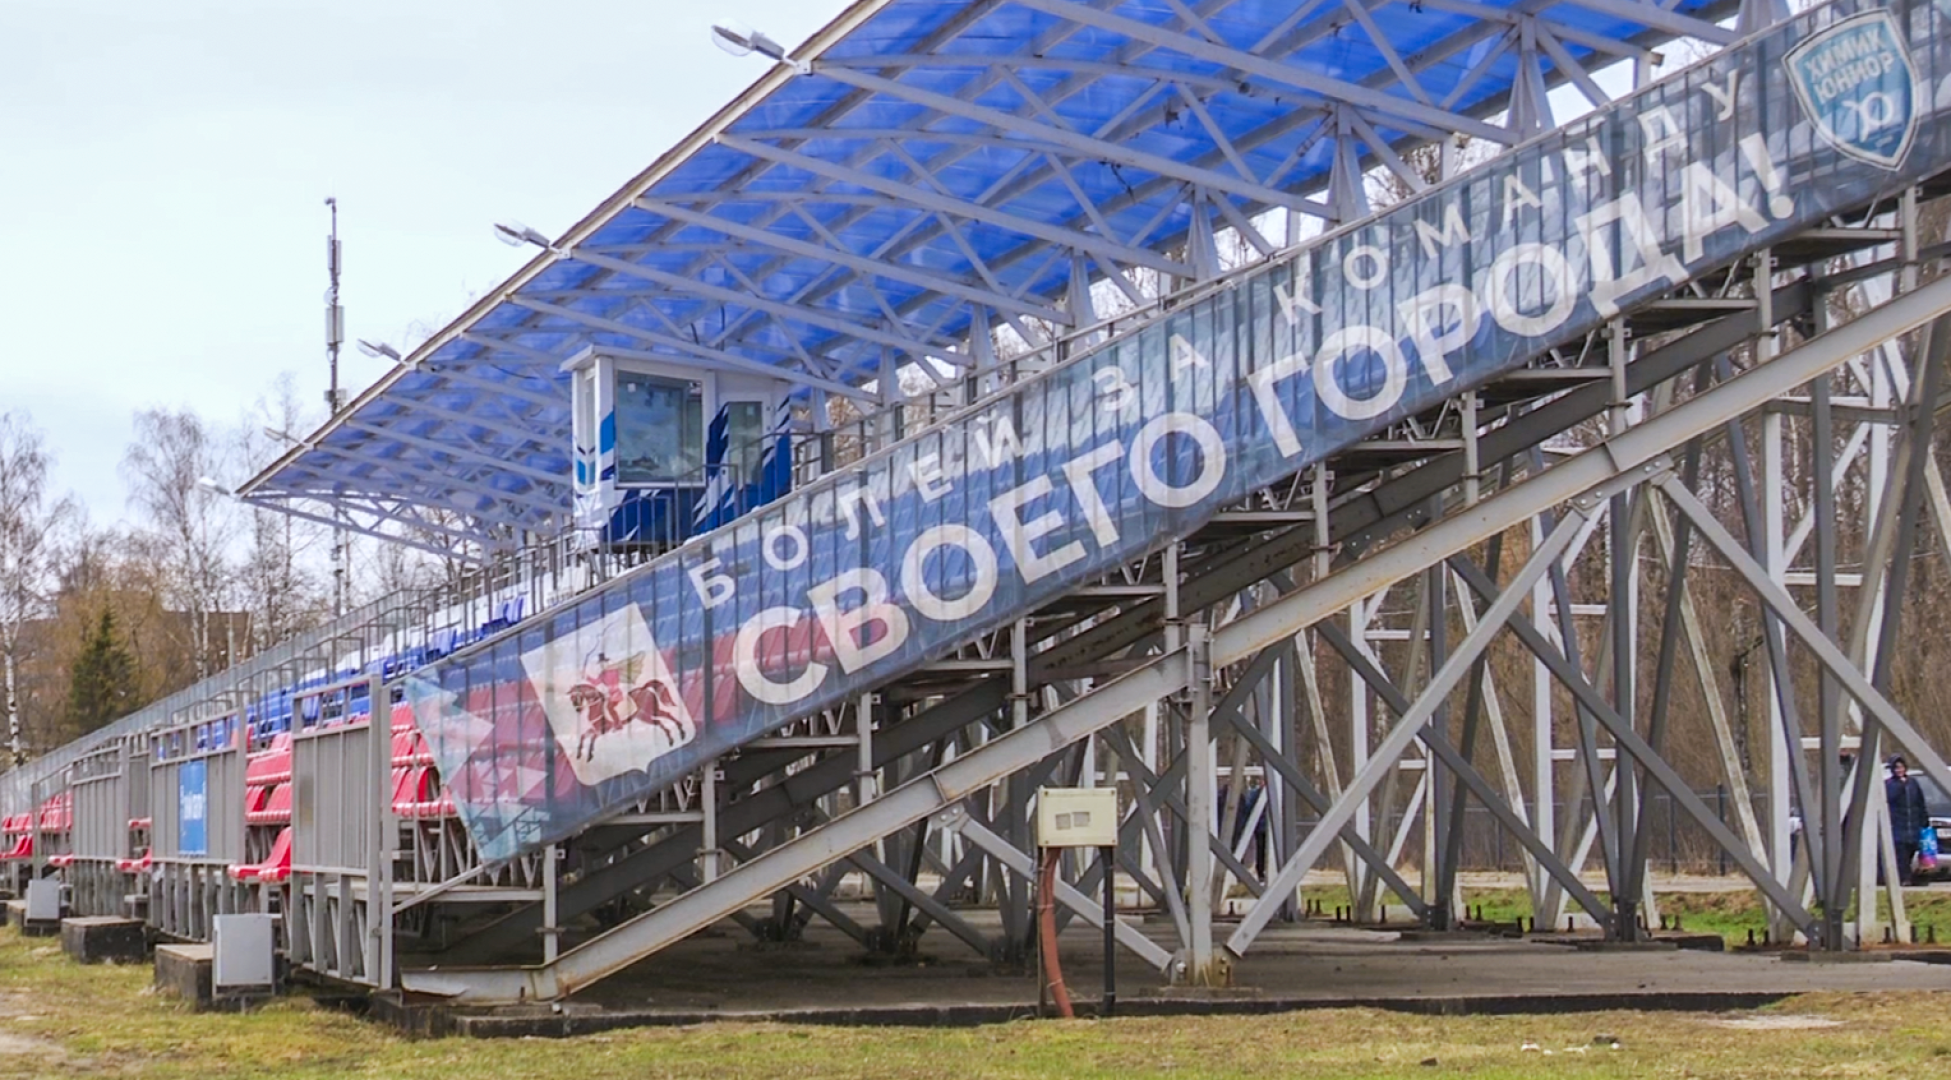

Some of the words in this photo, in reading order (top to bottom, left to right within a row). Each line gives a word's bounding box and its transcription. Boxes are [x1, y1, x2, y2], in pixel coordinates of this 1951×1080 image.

[1804, 28, 1886, 82] ХИМИК
[1812, 51, 1895, 104] ЮНИОР
[688, 410, 1024, 609] БОЛЕЙ
[1092, 332, 1210, 412] ЗА
[1273, 68, 1740, 326] КОМАНДУ
[733, 412, 1227, 705] СВОЕГО
[1247, 132, 1796, 459] ГОРОДА!
